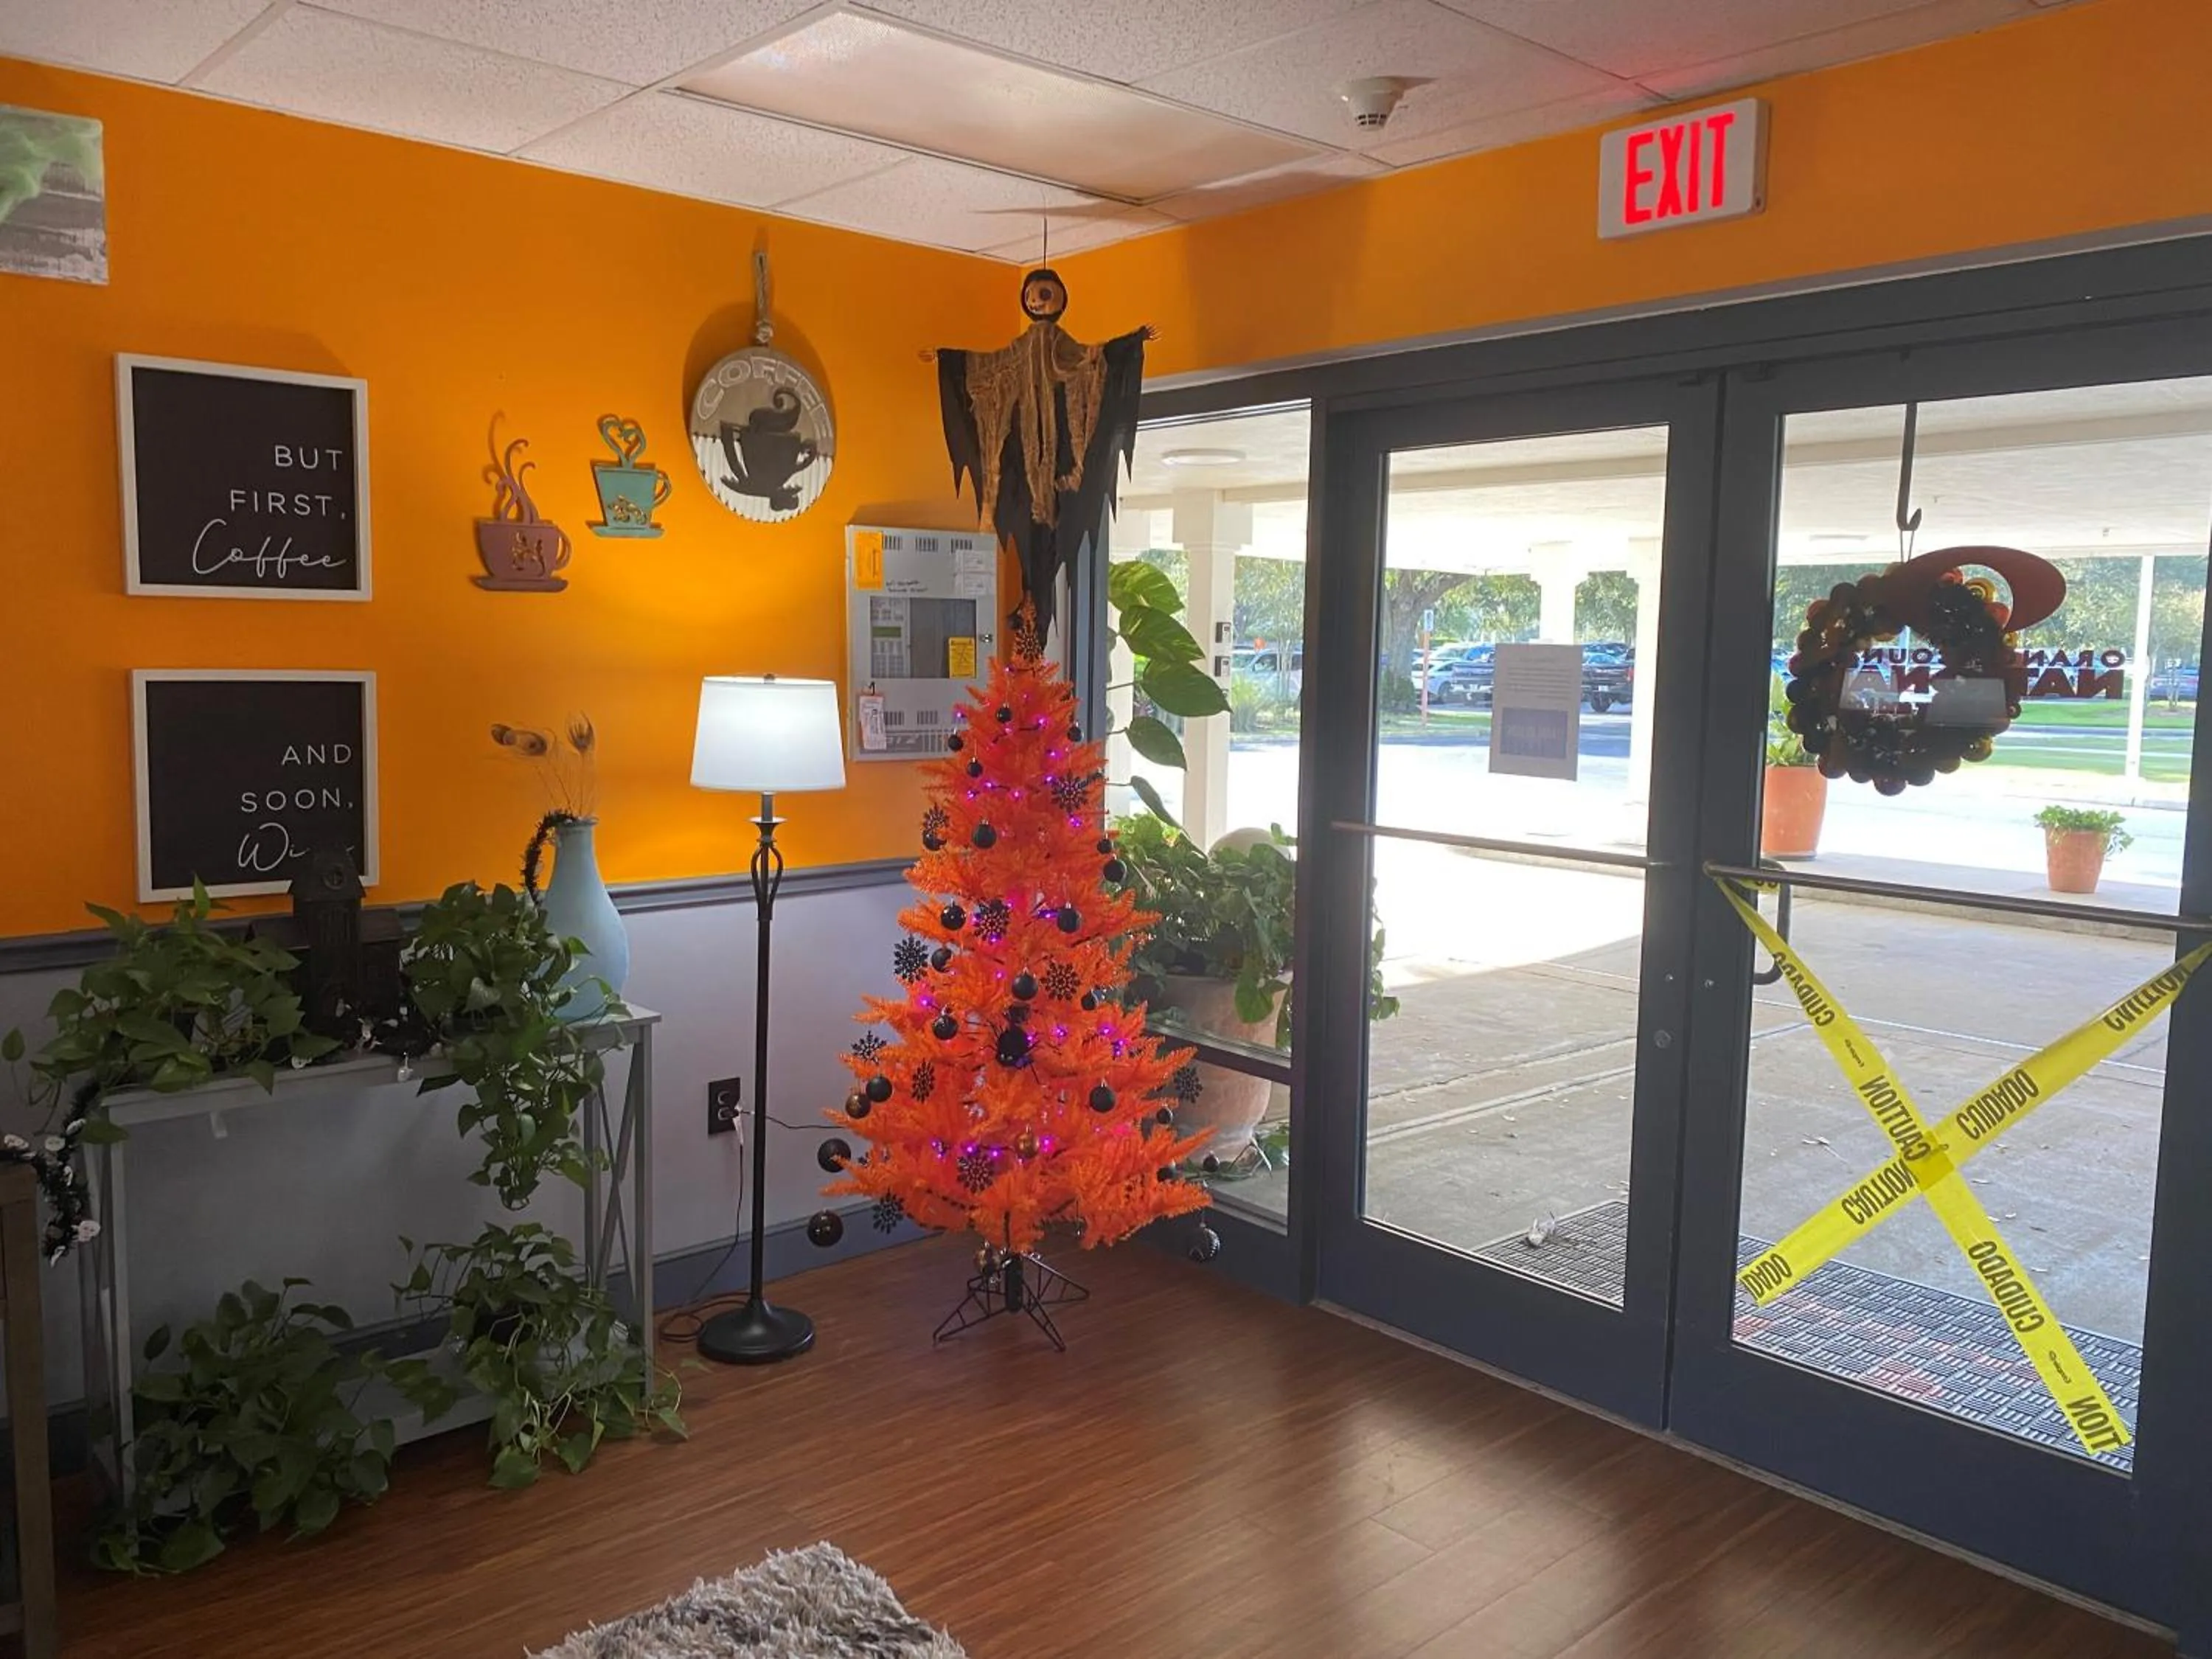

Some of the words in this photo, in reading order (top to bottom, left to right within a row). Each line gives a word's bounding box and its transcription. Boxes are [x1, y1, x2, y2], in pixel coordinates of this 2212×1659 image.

[1624, 111, 1735, 225] EXIT
[697, 355, 834, 439] COFFEE
[274, 445, 343, 470] BUT
[229, 490, 347, 519] FIRST,
[192, 518, 347, 579] Coffee
[281, 743, 352, 766] AND
[240, 787, 354, 813] SOON,
